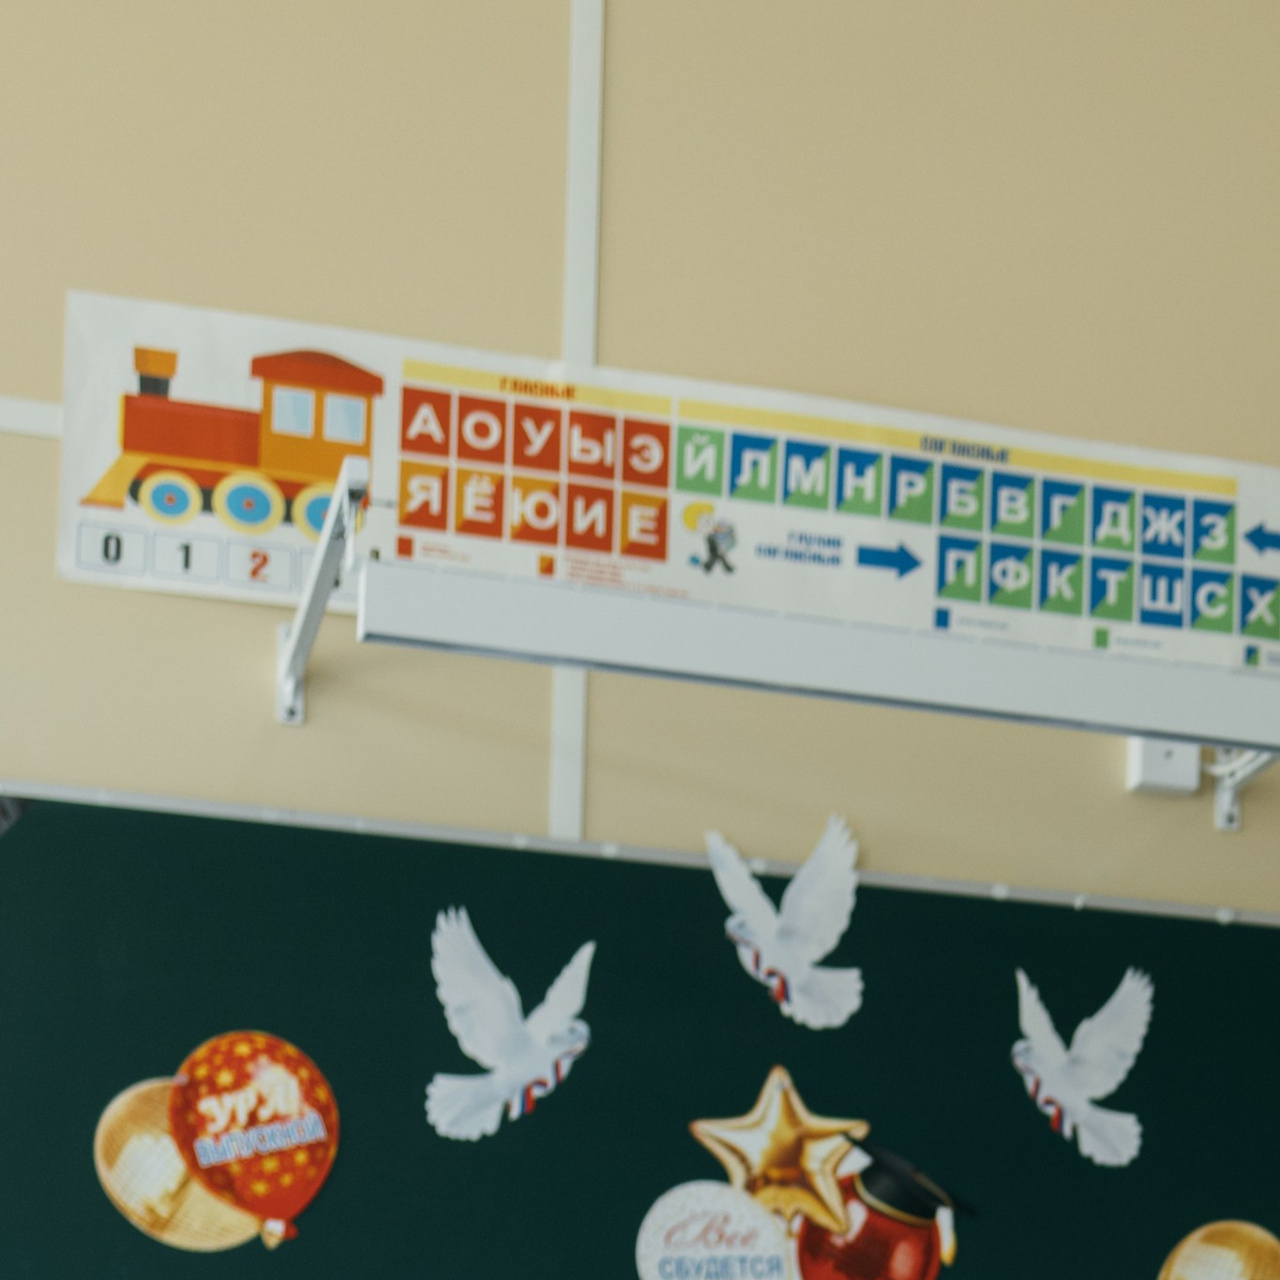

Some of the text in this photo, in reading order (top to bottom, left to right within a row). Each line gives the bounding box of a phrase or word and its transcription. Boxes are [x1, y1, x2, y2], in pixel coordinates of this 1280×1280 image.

[407, 403, 662, 473] А О У Ы Э
[406, 475, 660, 545] Я Ё Ю И Е
[683, 435, 1230, 551] Й Л М Н Р Б В Г Д Ж З
[103, 533, 269, 582] 0 1 2
[945, 548, 977, 587] П
[992, 551, 1031, 592] Ф
[1047, 563, 1076, 600] К
[1097, 569, 1128, 605] Т
[1142, 575, 1184, 615] Ш
[1195, 582, 1229, 618] С
[1246, 588, 1277, 626] Х
[658, 1254, 783, 1280] СБУДЕТСЯ
